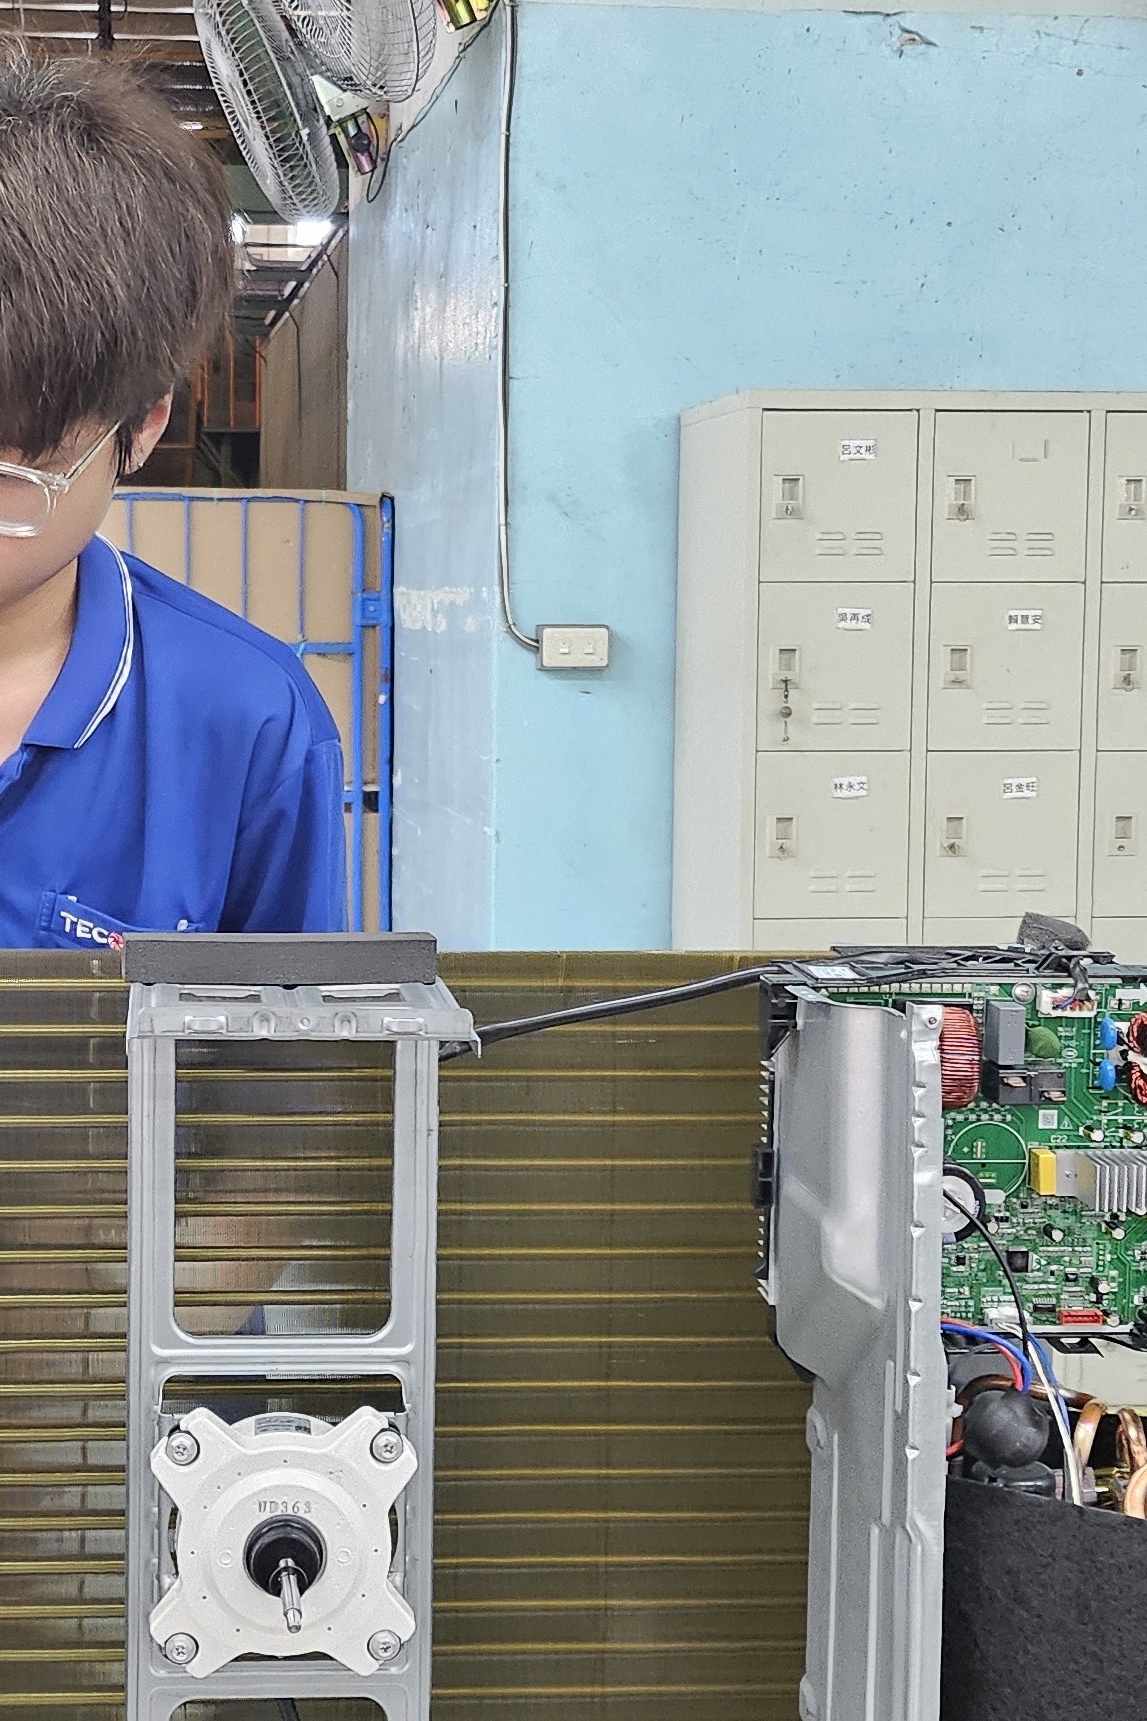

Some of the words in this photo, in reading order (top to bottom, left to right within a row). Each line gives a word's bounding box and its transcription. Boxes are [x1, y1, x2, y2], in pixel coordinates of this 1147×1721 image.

[833, 781, 868, 793] 林永文
[1002, 781, 1037, 794] 呂金旺
